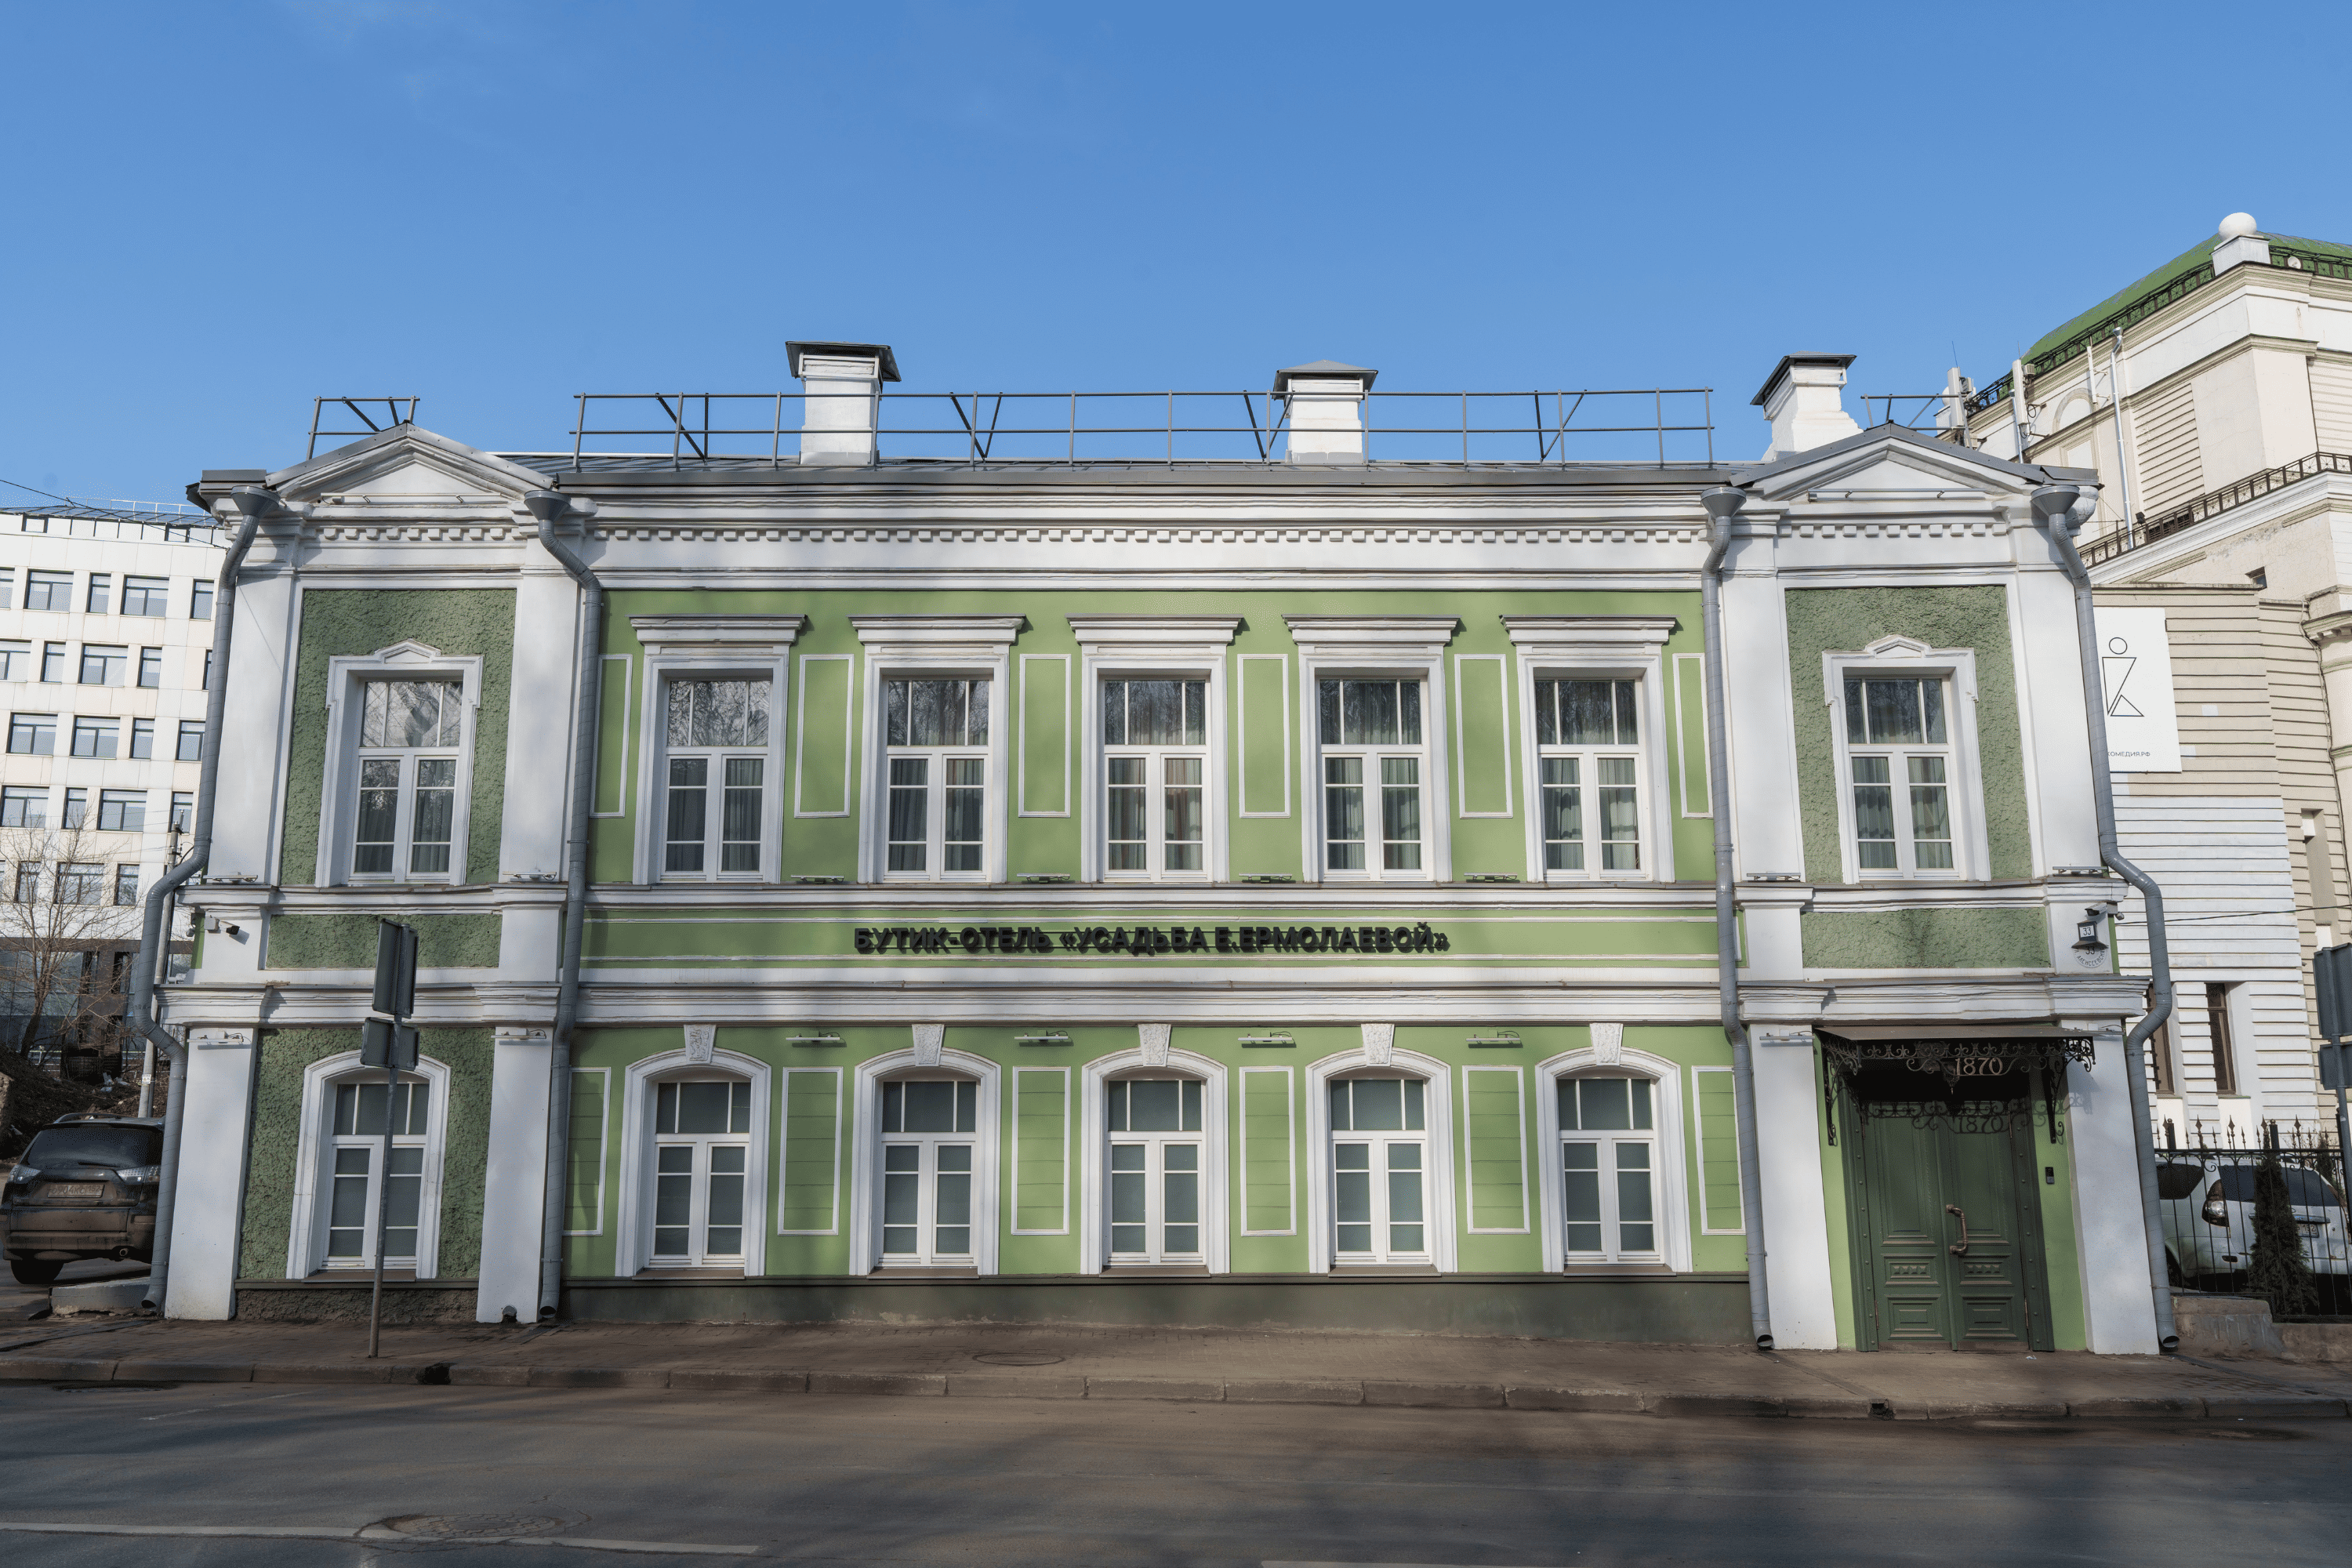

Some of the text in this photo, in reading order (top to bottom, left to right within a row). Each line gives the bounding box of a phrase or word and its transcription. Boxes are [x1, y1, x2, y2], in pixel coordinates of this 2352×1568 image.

[854, 926, 1051, 949] БУТИК-ОТЕЛЬ
[1058, 925, 1209, 951] «УСАДЬБА
[1955, 1057, 2003, 1076] 1870
